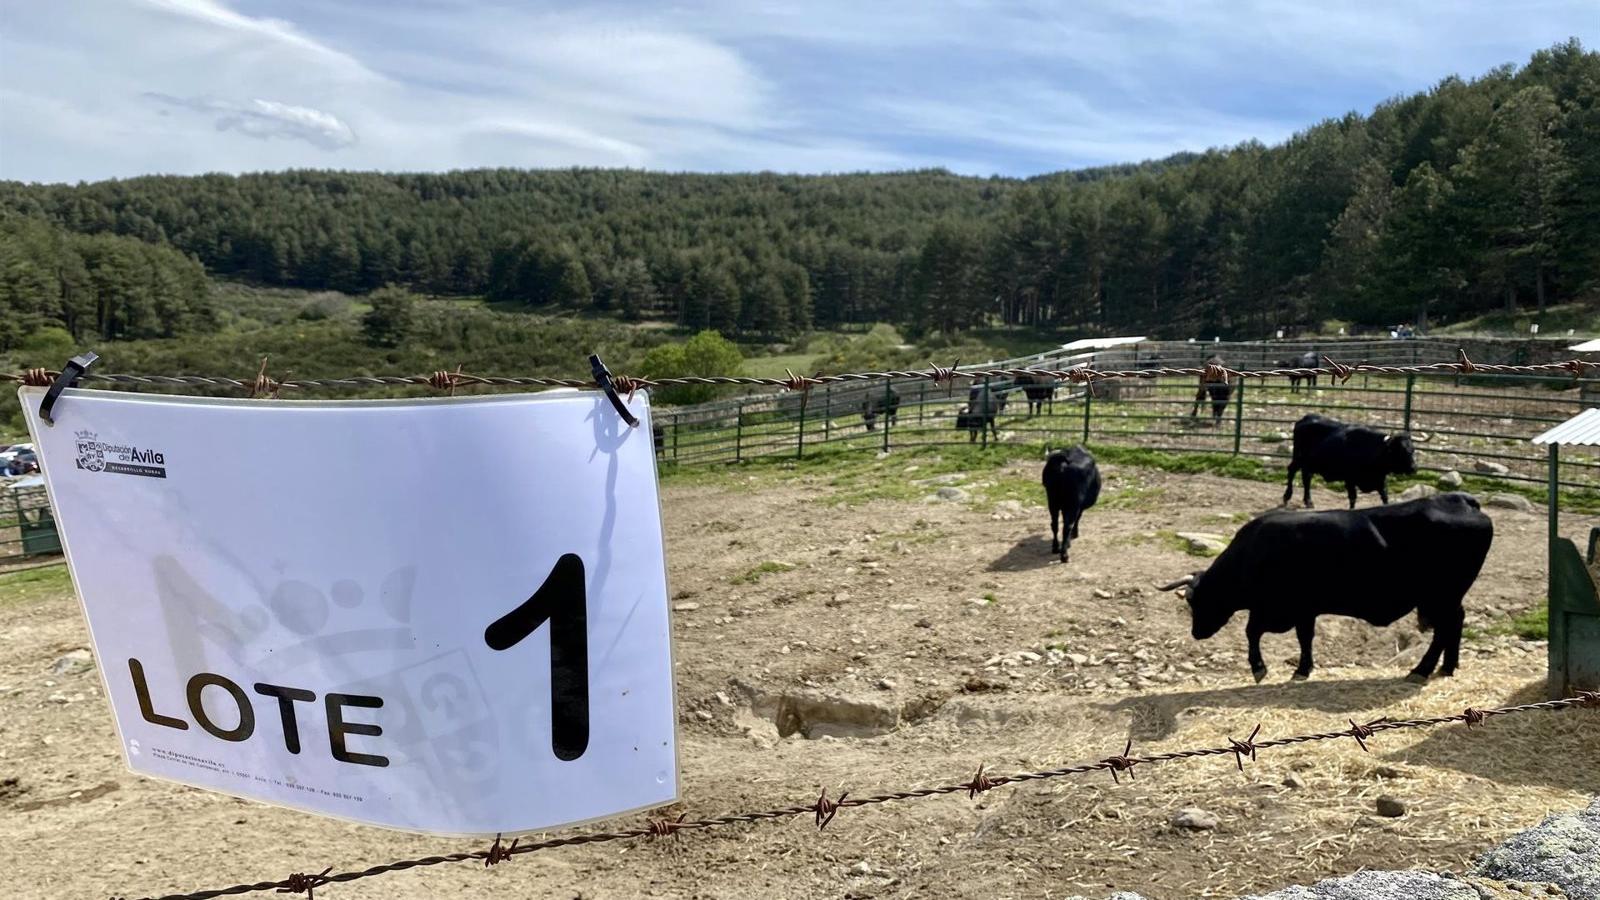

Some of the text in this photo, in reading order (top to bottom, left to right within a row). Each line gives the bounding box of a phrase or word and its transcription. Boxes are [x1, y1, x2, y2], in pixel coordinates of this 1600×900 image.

[102, 442, 132, 454] Diputación
[131, 446, 165, 465] Ávila
[129, 553, 589, 767] LOTE 1
